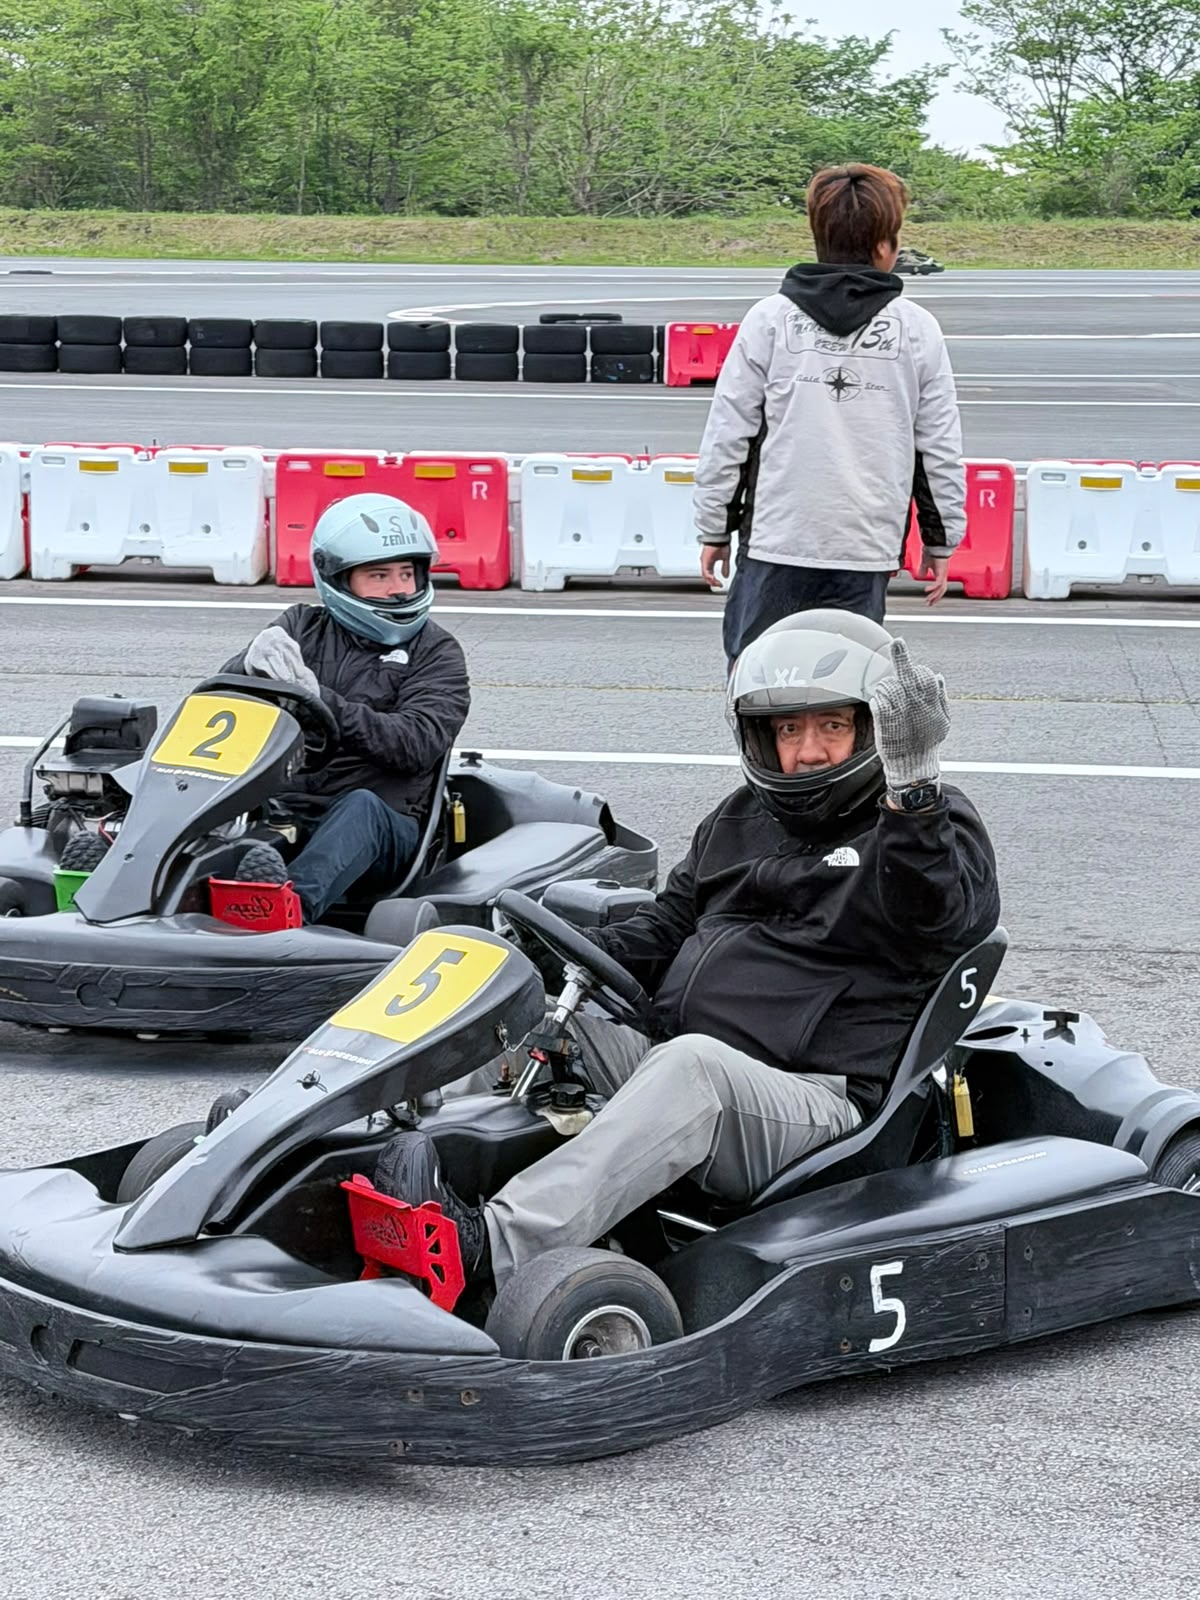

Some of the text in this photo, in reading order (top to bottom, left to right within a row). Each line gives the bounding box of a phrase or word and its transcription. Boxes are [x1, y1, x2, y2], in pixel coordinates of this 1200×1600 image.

[472, 481, 488, 500] R
[980, 489, 995, 508] R
[774, 666, 808, 688] XL
[188, 710, 237, 760] 2
[385, 948, 468, 1017] 5
[959, 967, 978, 1010] 5
[868, 1261, 907, 1353] 5
